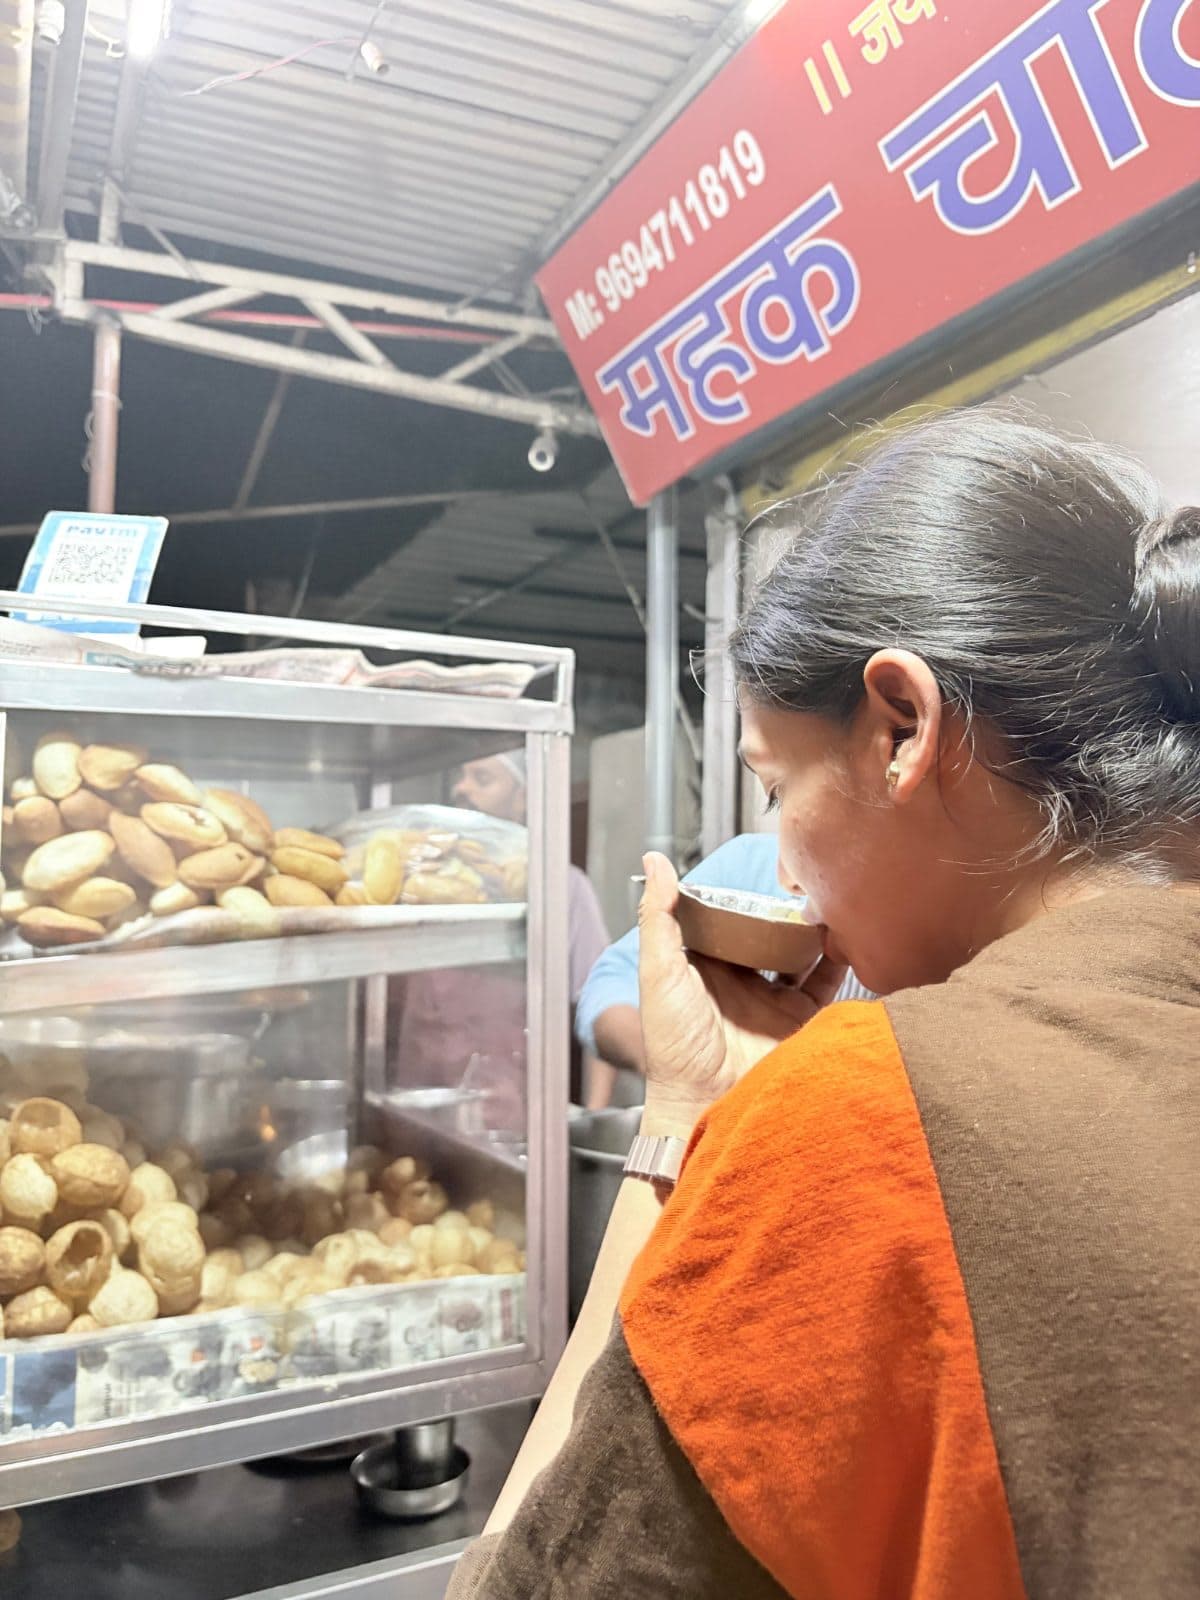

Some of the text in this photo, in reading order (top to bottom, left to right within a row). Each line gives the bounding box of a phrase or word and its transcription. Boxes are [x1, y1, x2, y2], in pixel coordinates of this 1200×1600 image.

[565, 129, 765, 341] M: 9694711819
[595, 182, 861, 443] महक
